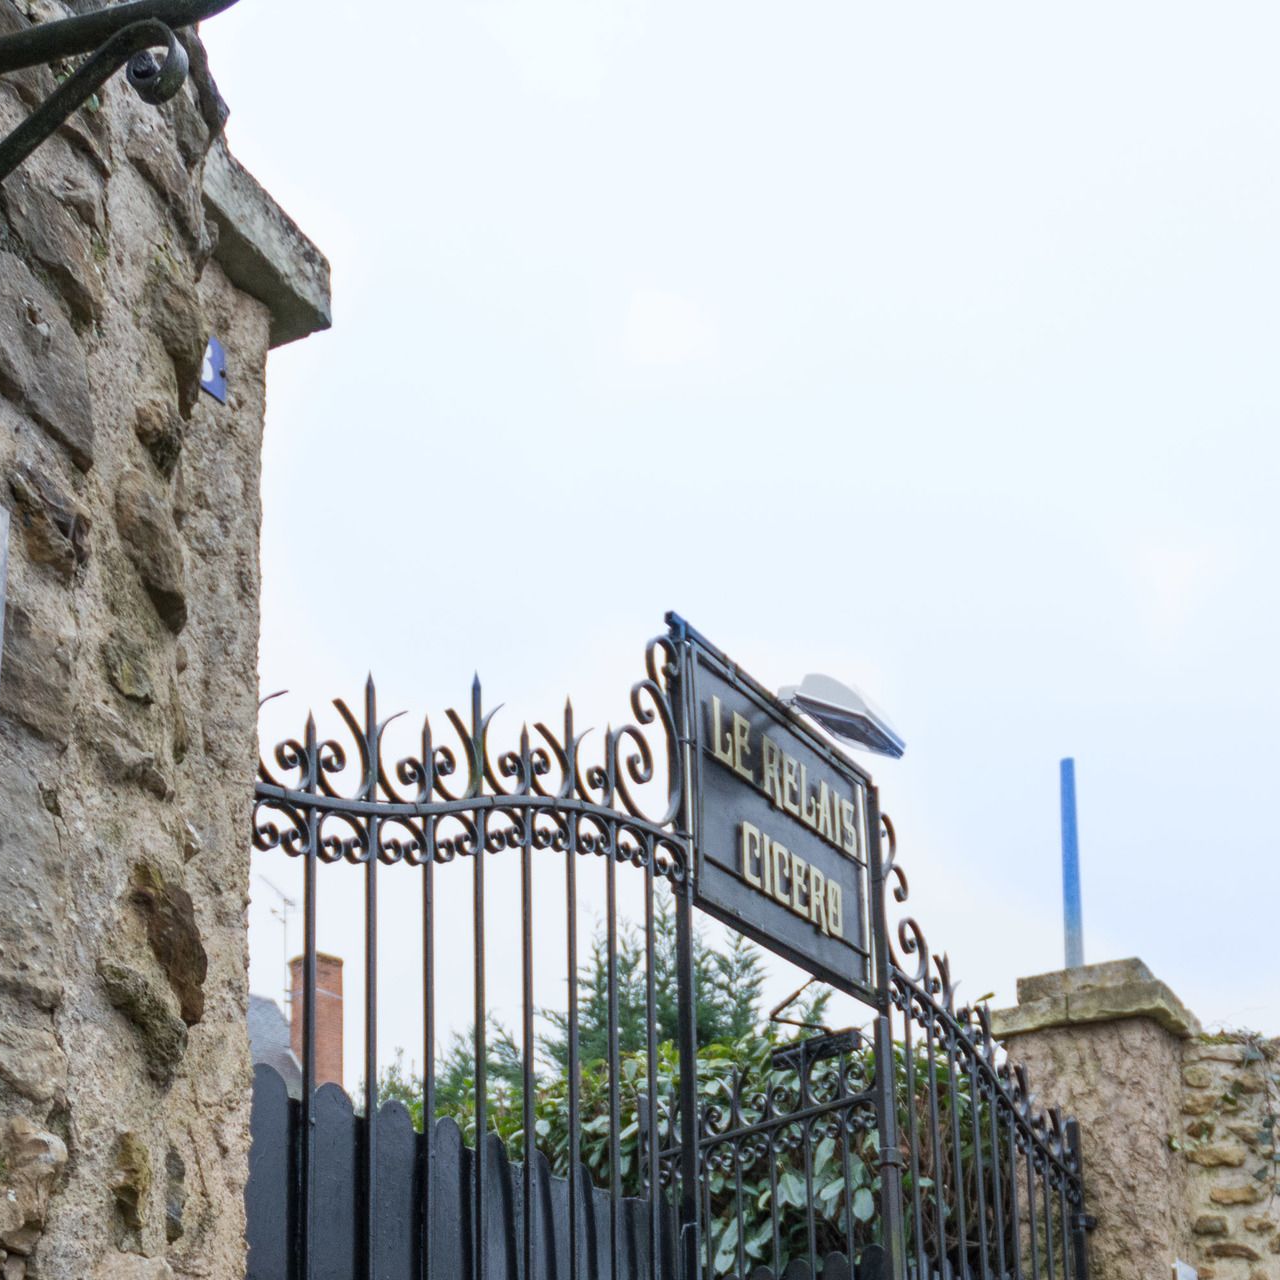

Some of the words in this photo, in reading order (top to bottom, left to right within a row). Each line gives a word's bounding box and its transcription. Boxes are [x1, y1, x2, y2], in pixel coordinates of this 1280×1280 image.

[712, 695, 753, 782] LE
[762, 733, 858, 858] RELAIS
[742, 820, 844, 938] CICERO
